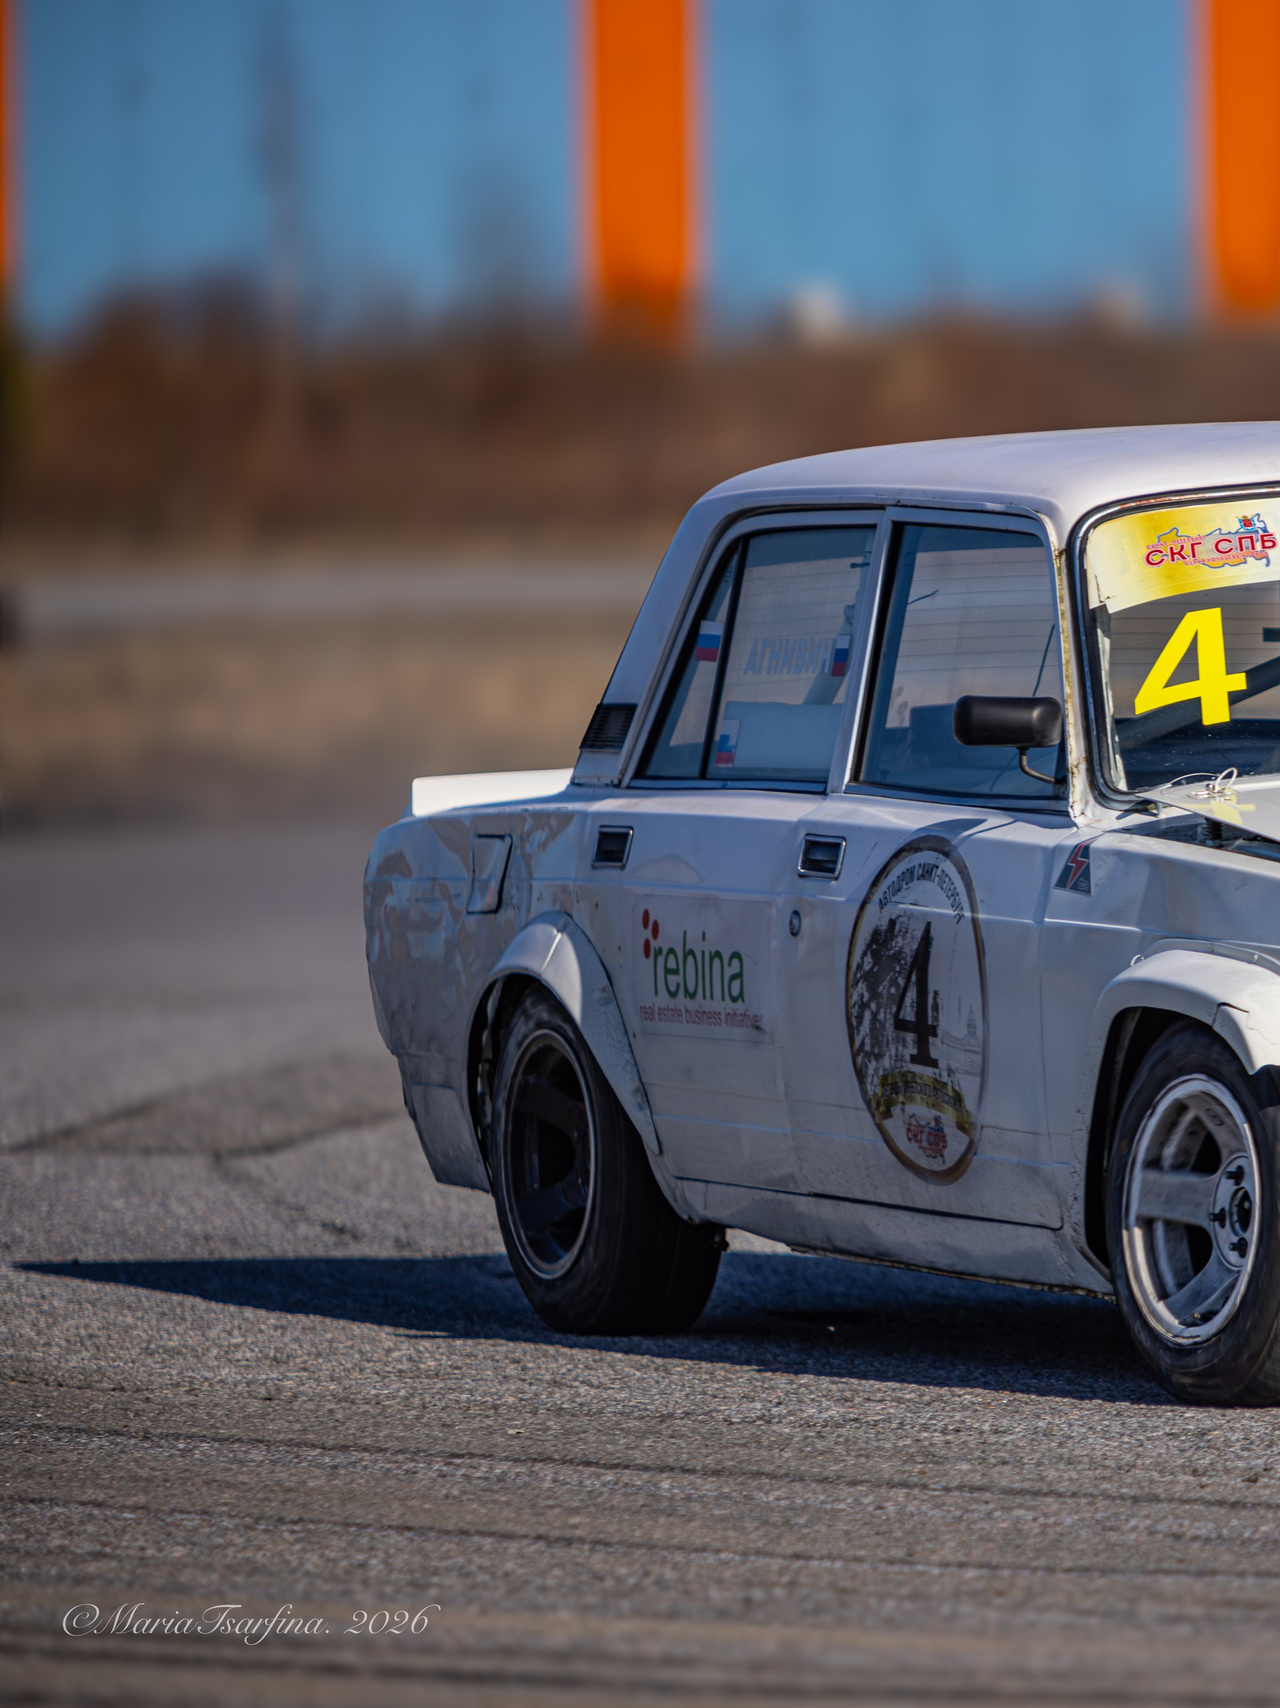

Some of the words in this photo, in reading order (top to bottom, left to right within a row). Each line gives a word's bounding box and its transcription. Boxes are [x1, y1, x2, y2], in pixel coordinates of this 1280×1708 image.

[1145, 541, 1203, 567] СКГ
[1214, 533, 1277, 555] СПБ
[1134, 607, 1248, 726] 4
[878, 864, 916, 914] АВТОДРОМ
[916, 862, 966, 925] САНКТ-ПЕТЕРБУРГ
[653, 929, 745, 1004] rebina
[894, 921, 939, 1069] 4
[639, 1002, 656, 1022] real
[657, 1004, 683, 1024] estate
[684, 1005, 723, 1027] business
[724, 1007, 763, 1029] initiative
